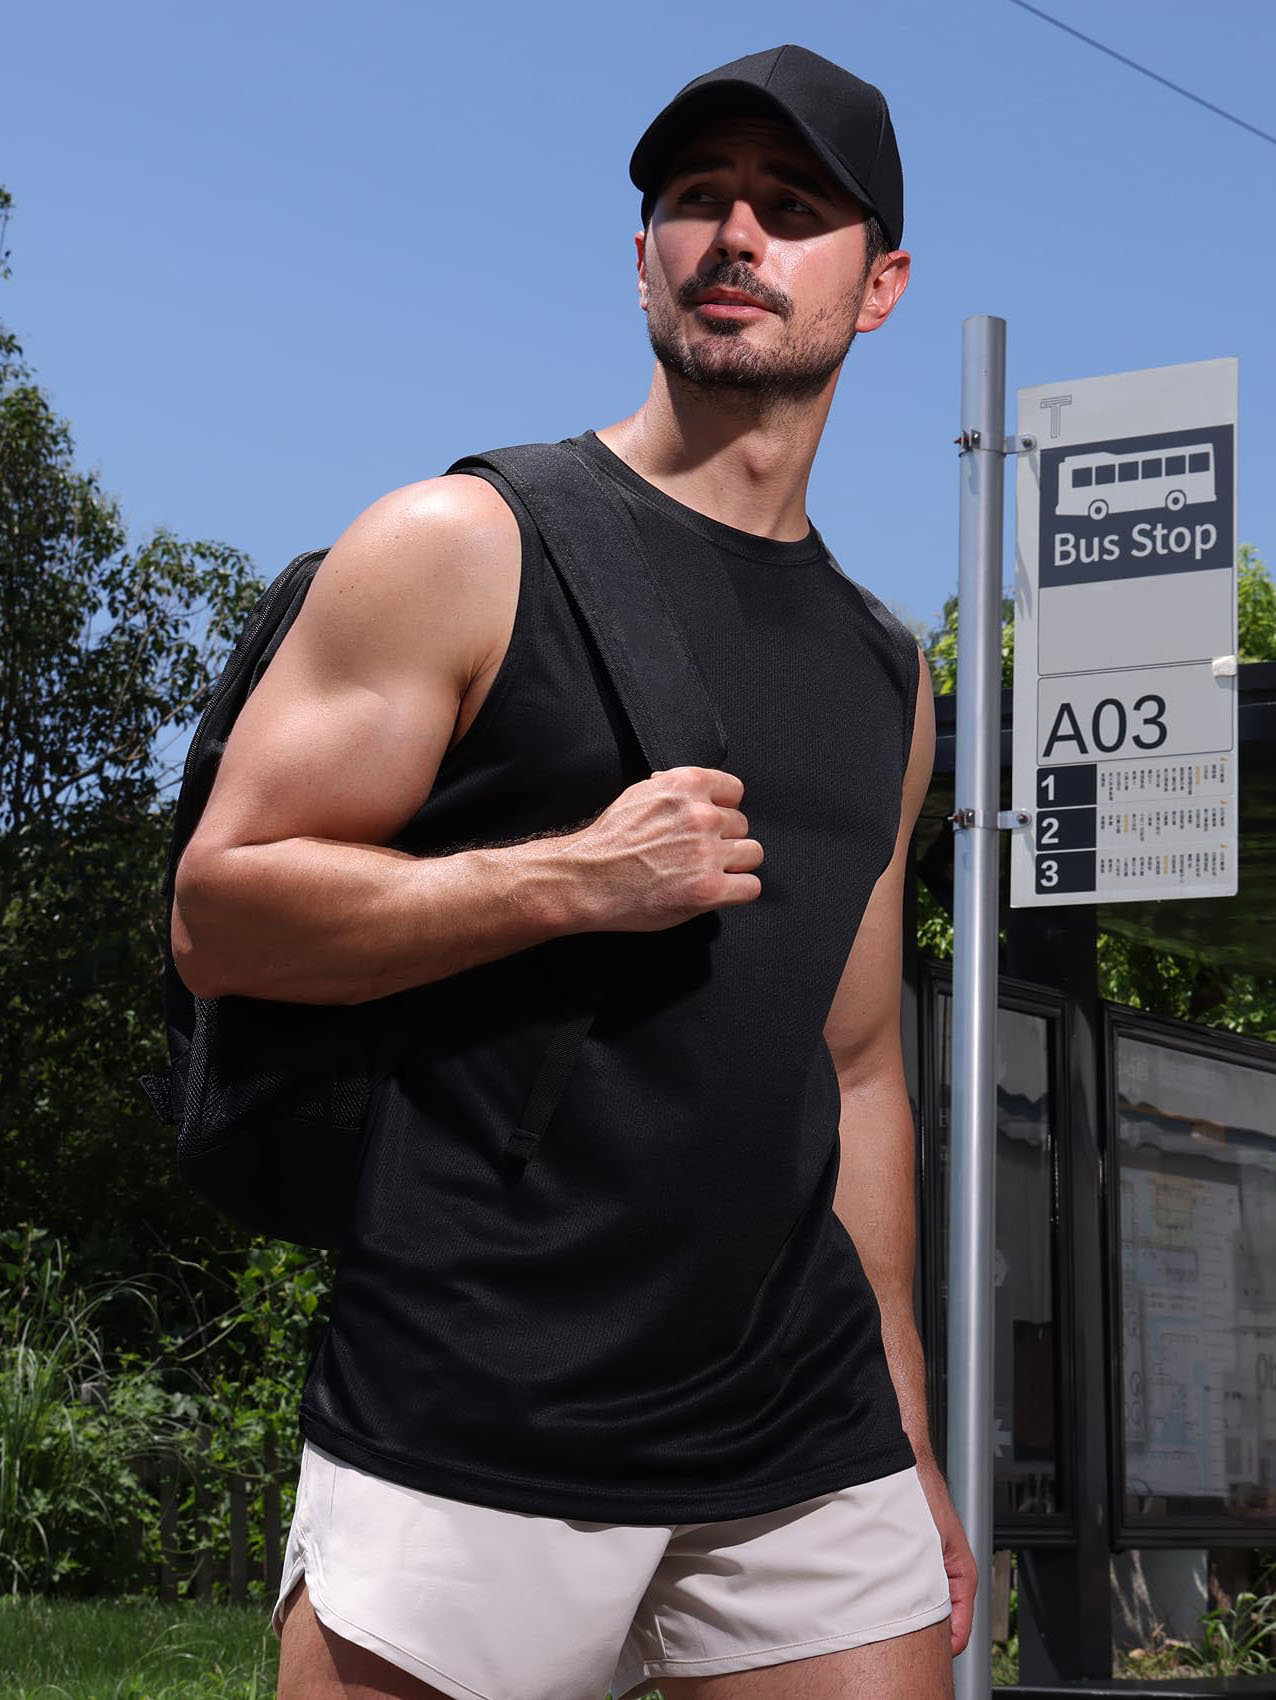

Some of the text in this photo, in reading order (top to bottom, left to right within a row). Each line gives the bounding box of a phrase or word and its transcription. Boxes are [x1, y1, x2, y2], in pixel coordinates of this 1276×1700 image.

[1054, 523, 1217, 566] Bus Stop
[1042, 694, 1168, 758] A03
[1040, 774, 1055, 801] 1
[1040, 817, 1059, 844] 2
[1040, 860, 1059, 887] 3
